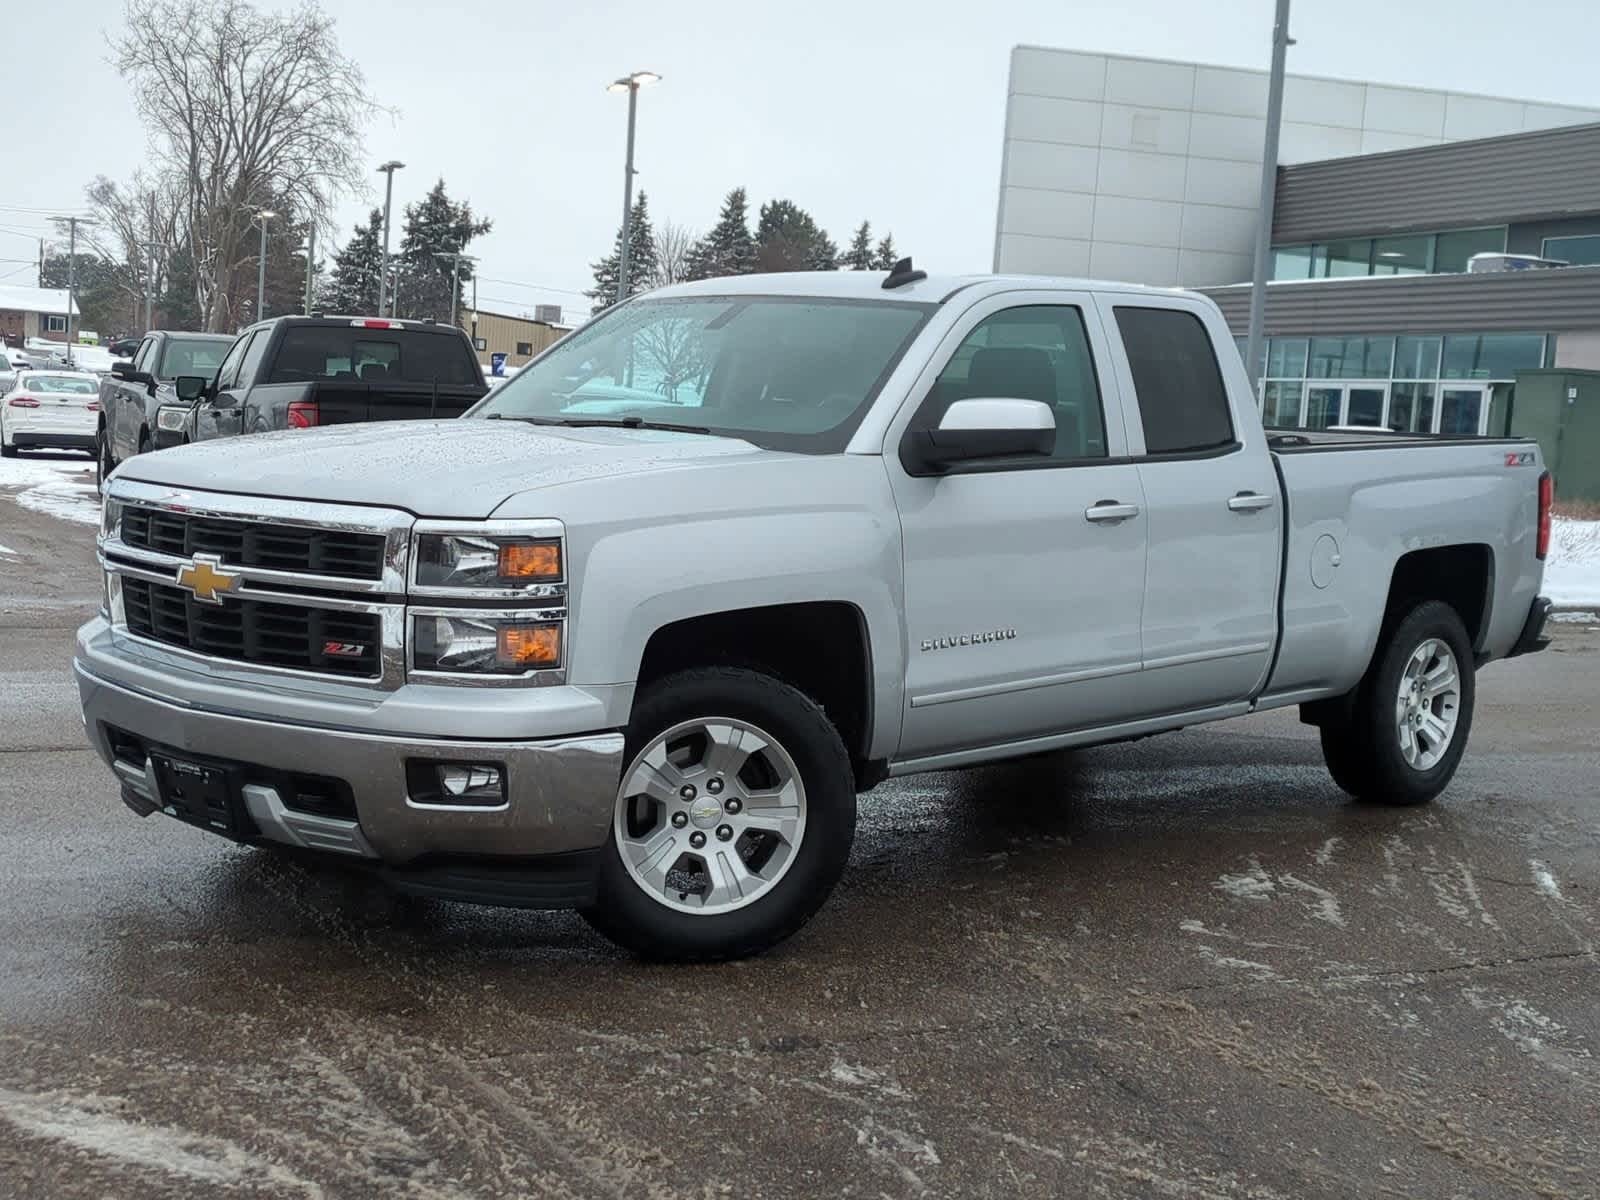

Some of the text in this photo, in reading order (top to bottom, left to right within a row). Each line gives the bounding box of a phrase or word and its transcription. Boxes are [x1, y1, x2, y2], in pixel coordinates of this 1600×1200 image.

[1504, 452, 1536, 467] Z71
[920, 628, 1017, 652] SILVERADO
[322, 641, 364, 656] Z71
